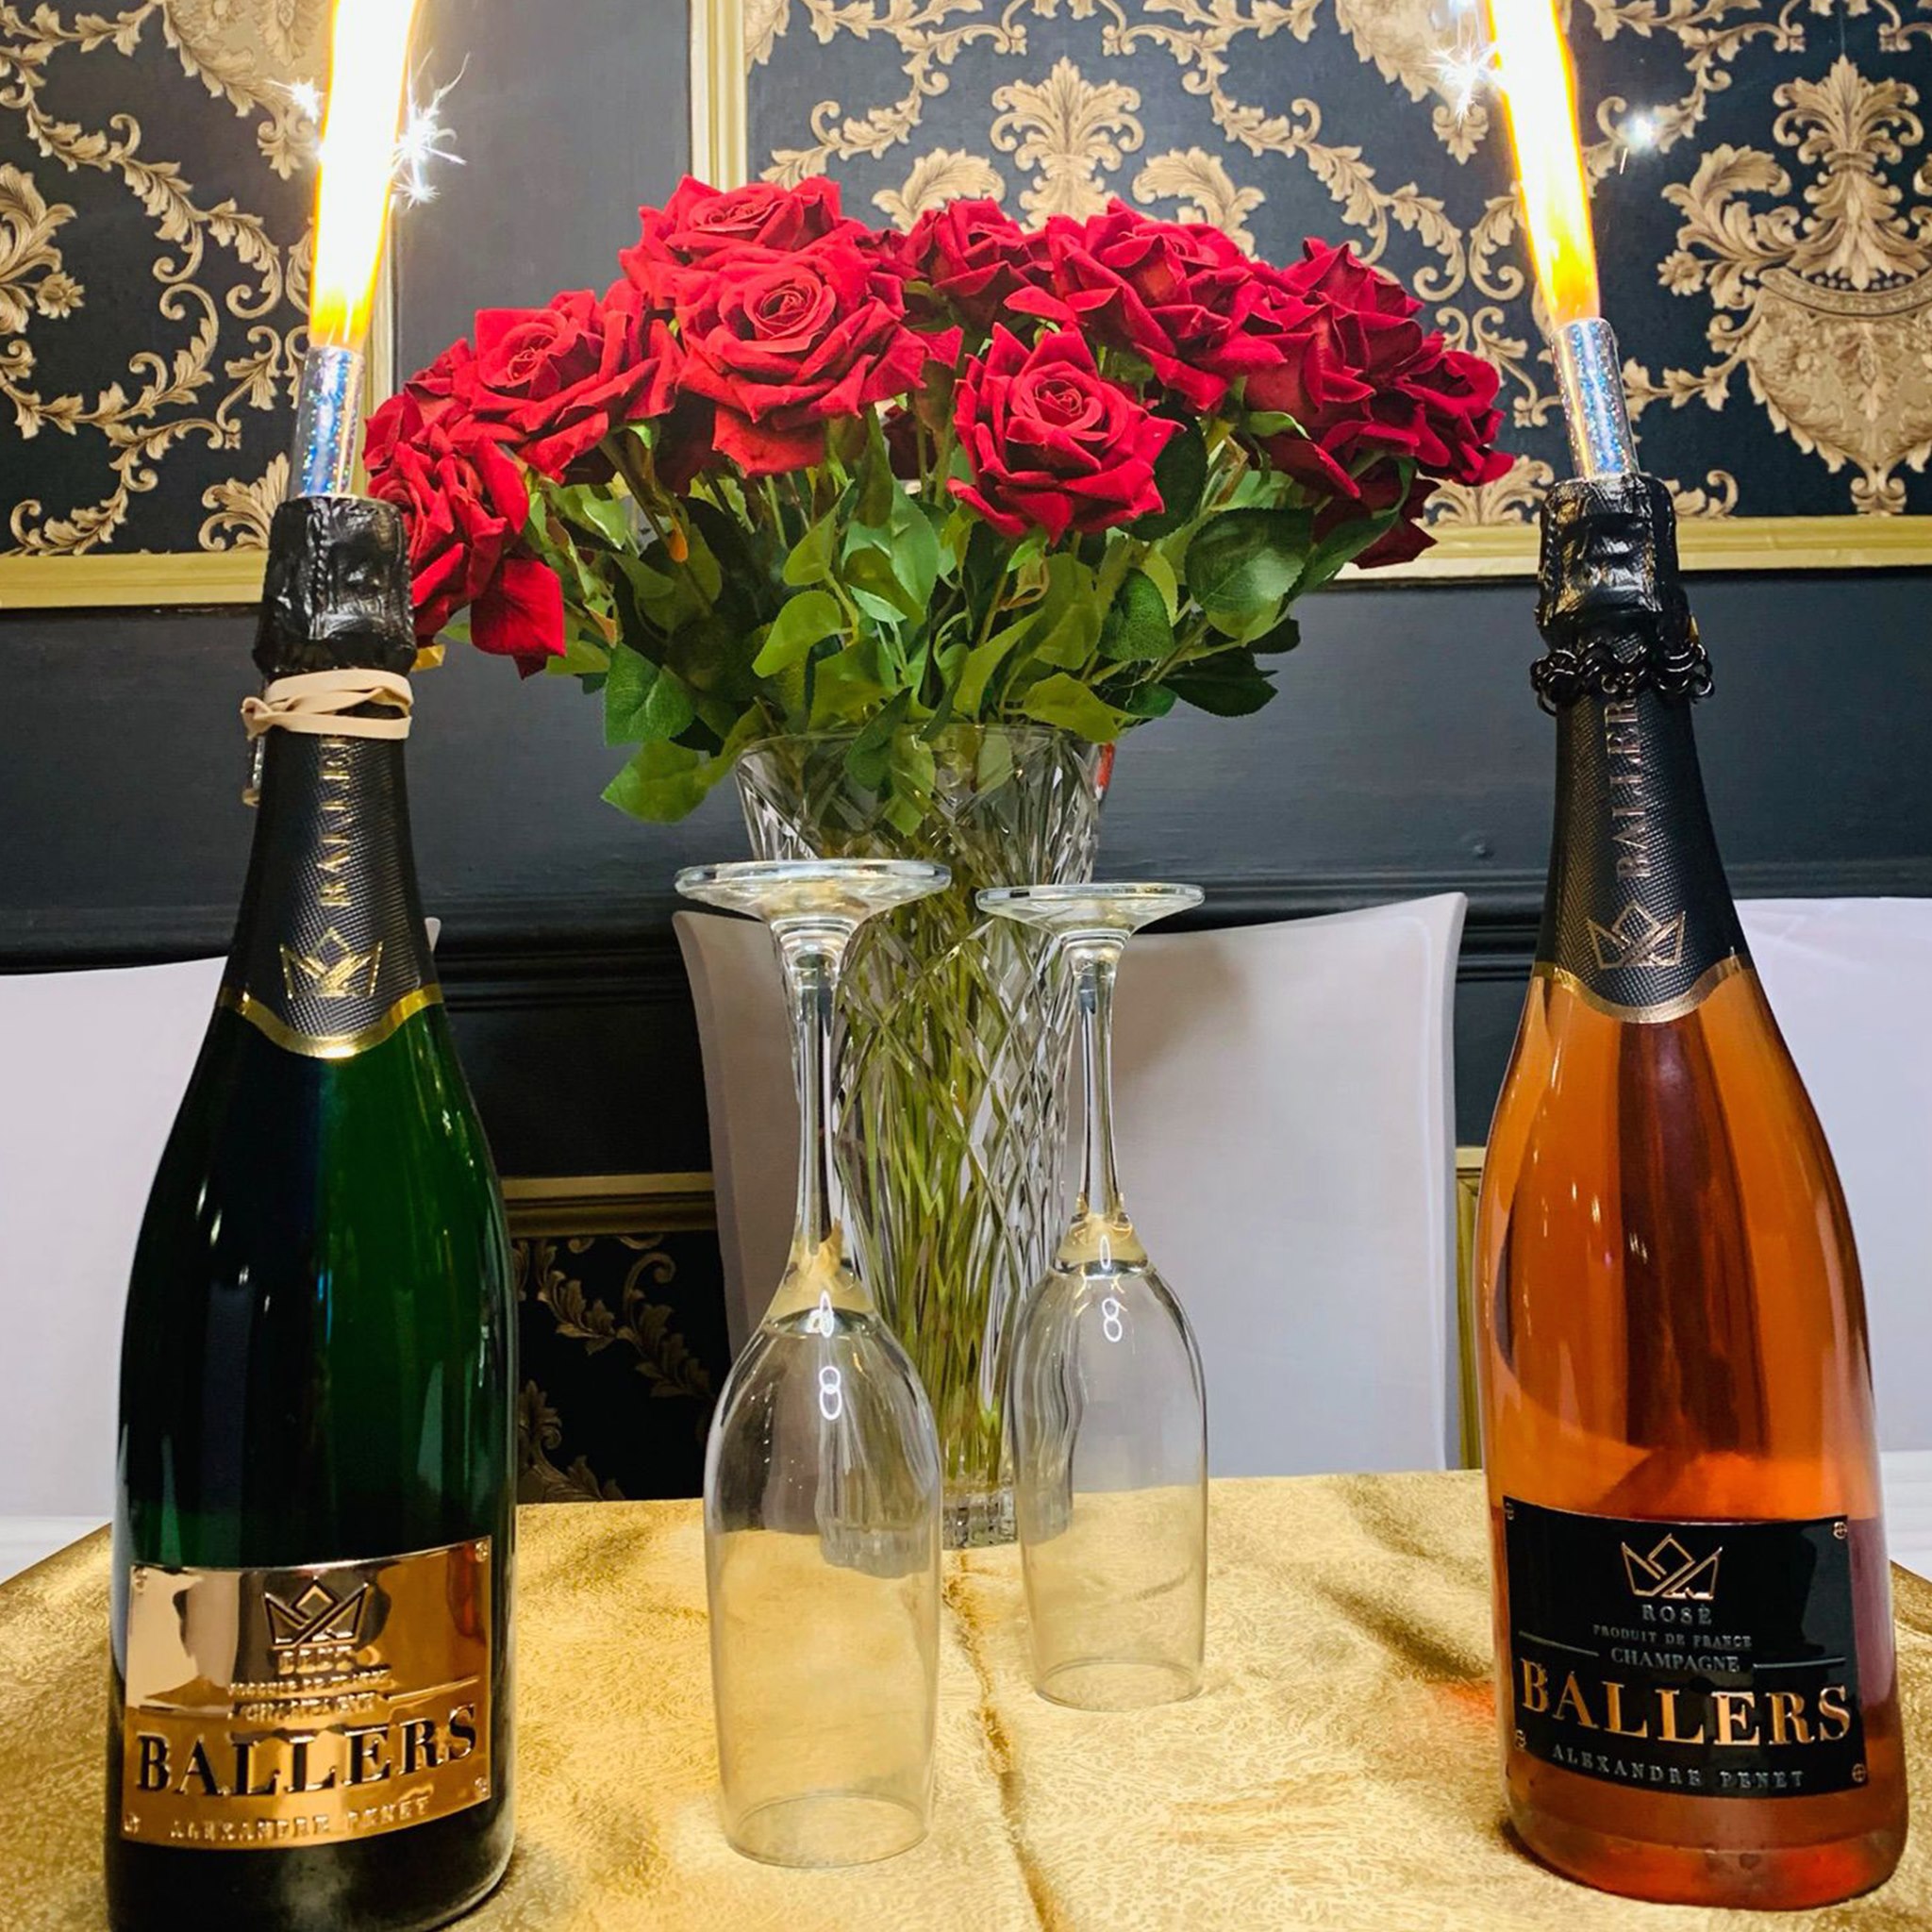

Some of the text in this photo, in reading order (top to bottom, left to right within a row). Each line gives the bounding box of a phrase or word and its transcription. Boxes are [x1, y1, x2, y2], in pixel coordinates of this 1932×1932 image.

[1592, 1624, 1753, 1649] PRODUIT DE FRANCE
[1610, 1646, 1740, 1674] CHAMPAGNE
[1519, 1657, 1852, 1747] BALLERS
[136, 1704, 478, 1798] BALLERS
[1552, 1743, 1805, 1789] ALEXANDRE PENET
